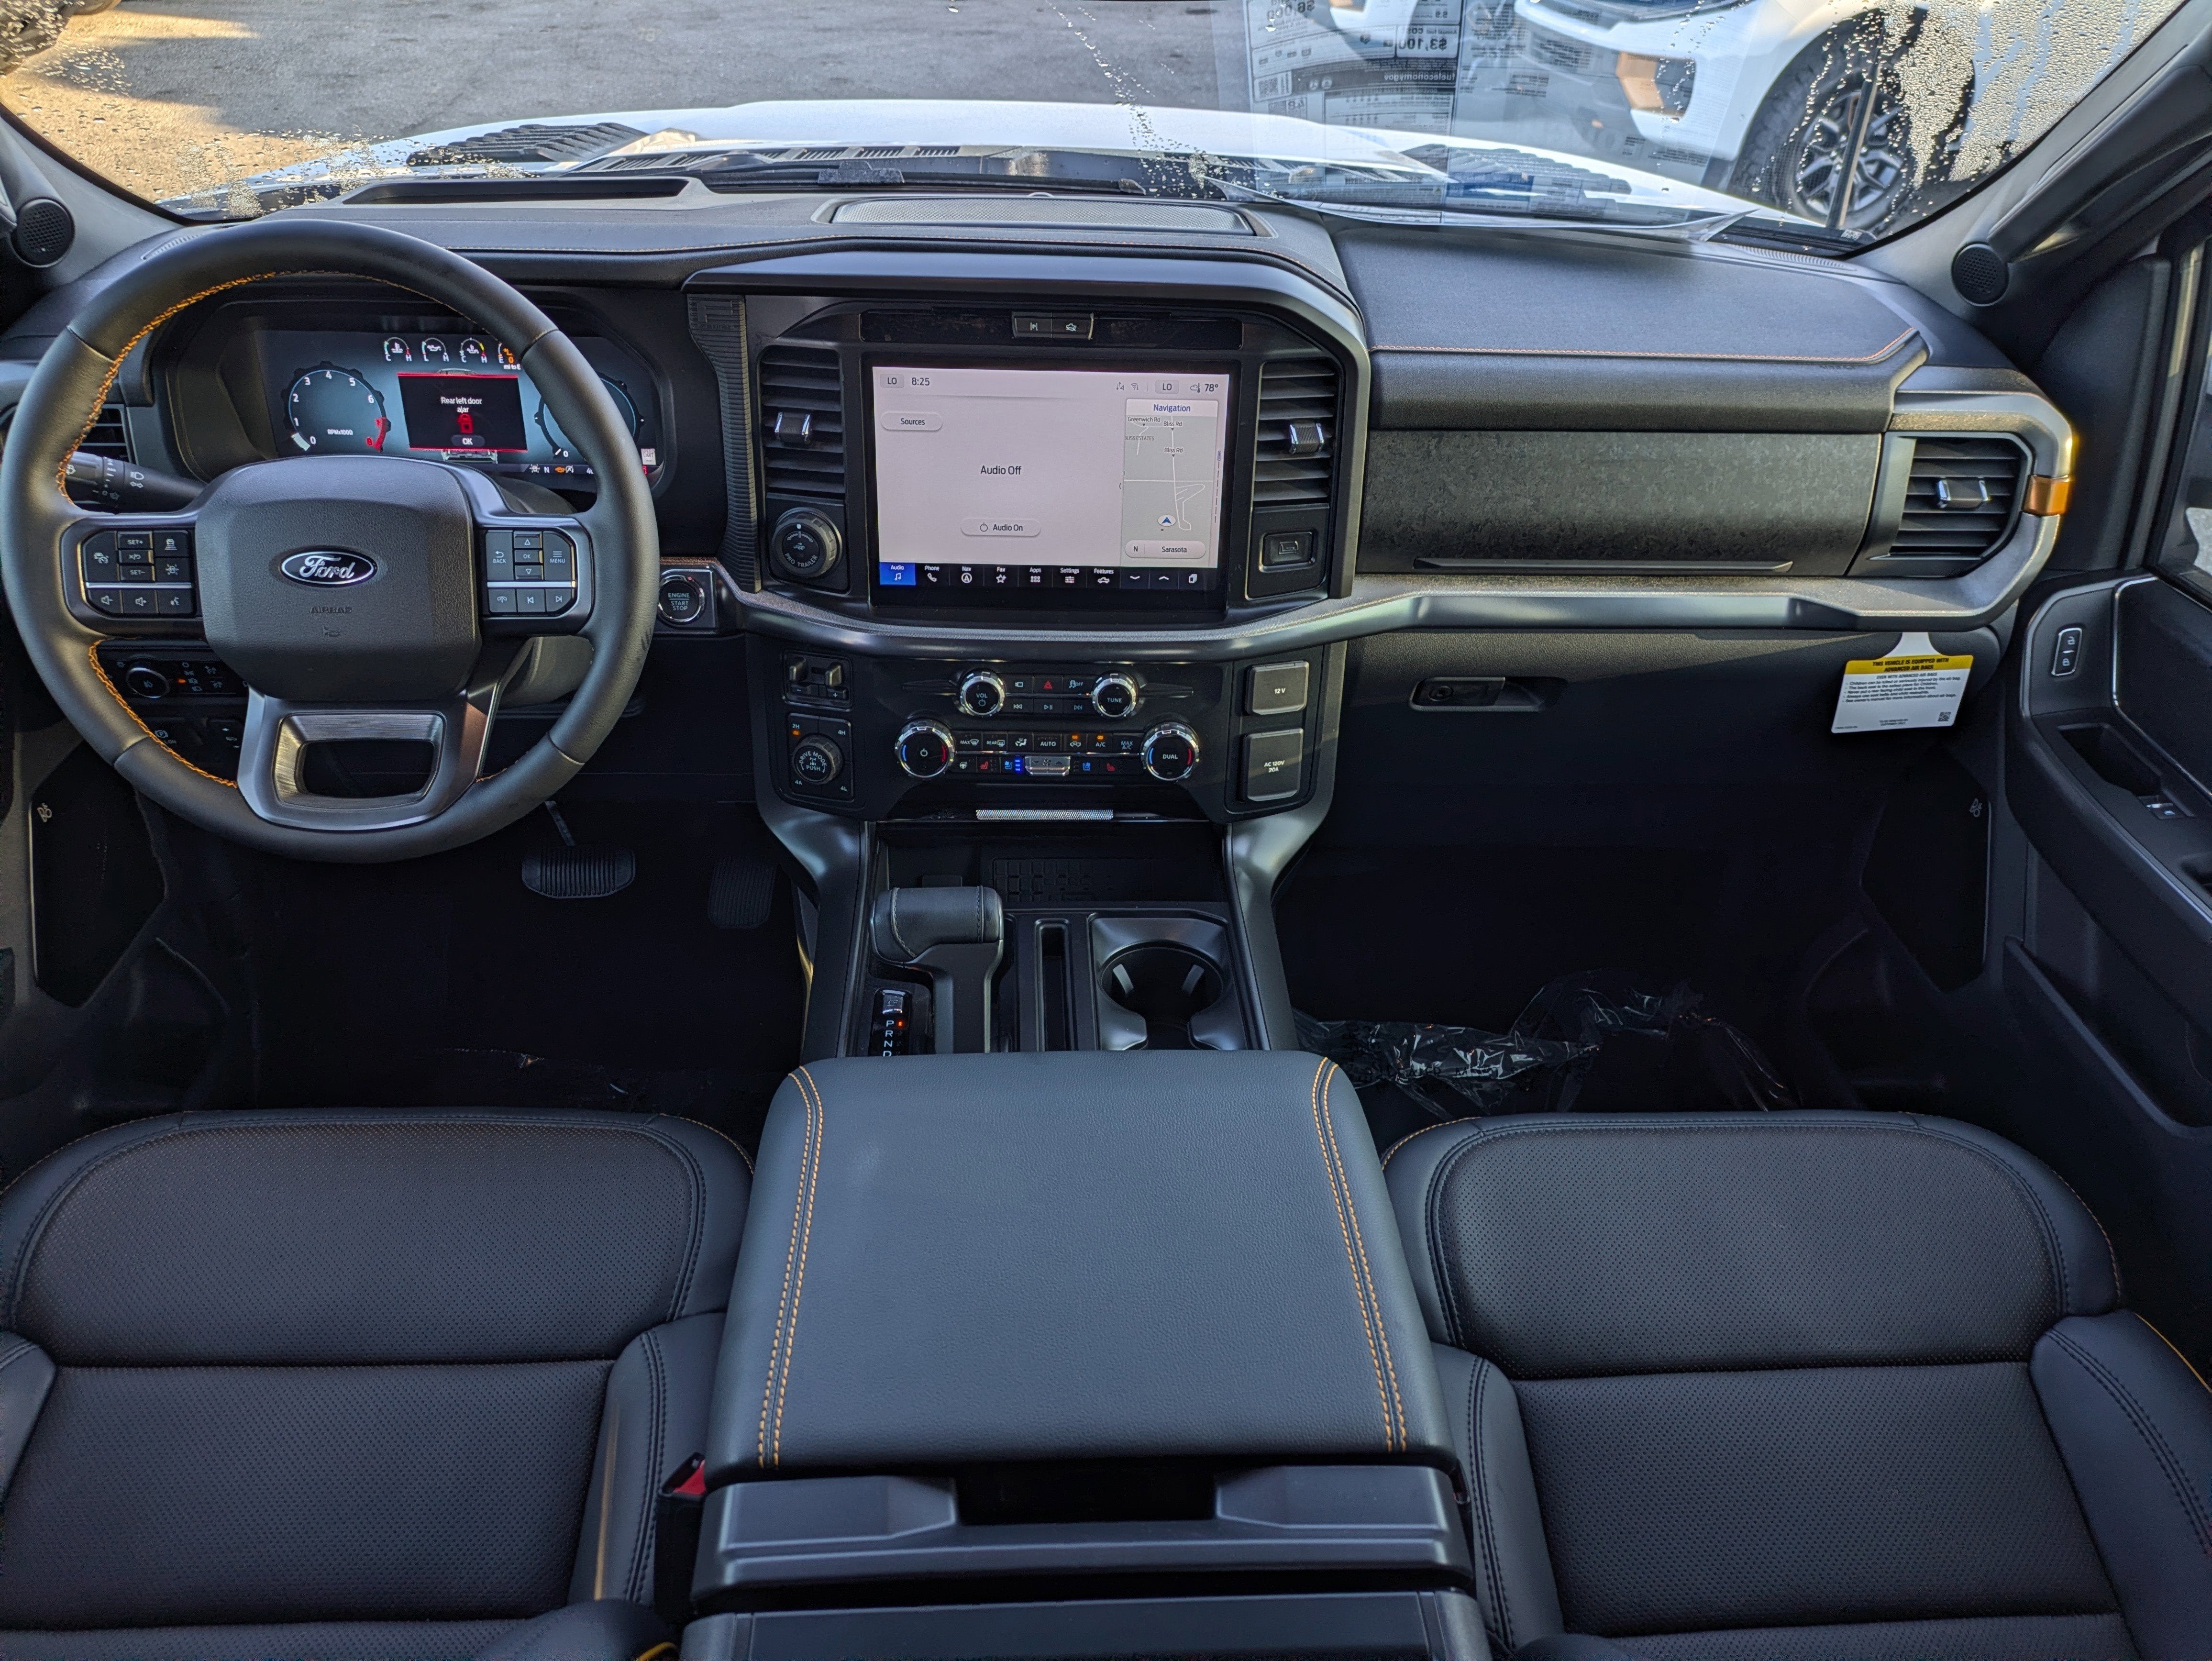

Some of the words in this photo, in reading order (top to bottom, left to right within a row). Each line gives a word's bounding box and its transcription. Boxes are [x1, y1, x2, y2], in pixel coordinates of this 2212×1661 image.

[443, 354, 449, 362] H
[325, 371, 332, 379] 4
[304, 376, 311, 386] 3
[349, 377, 355, 387] 5
[911, 377, 930, 386] 8:25
[1204, 384, 1218, 392] 78°
[292, 393, 299, 402] 2
[368, 395, 374, 404] 6
[1153, 404, 1191, 412] Navigation
[294, 417, 299, 426] 1
[310, 435, 316, 445] 0
[981, 465, 1006, 475] Audio
[1008, 465, 1022, 475] Off
[785, 553, 796, 565] PRO
[797, 555, 818, 567] TRAILER
[299, 555, 356, 579] Ford
[799, 751, 812, 764] DRIVE
[812, 751, 827, 766] MODE
